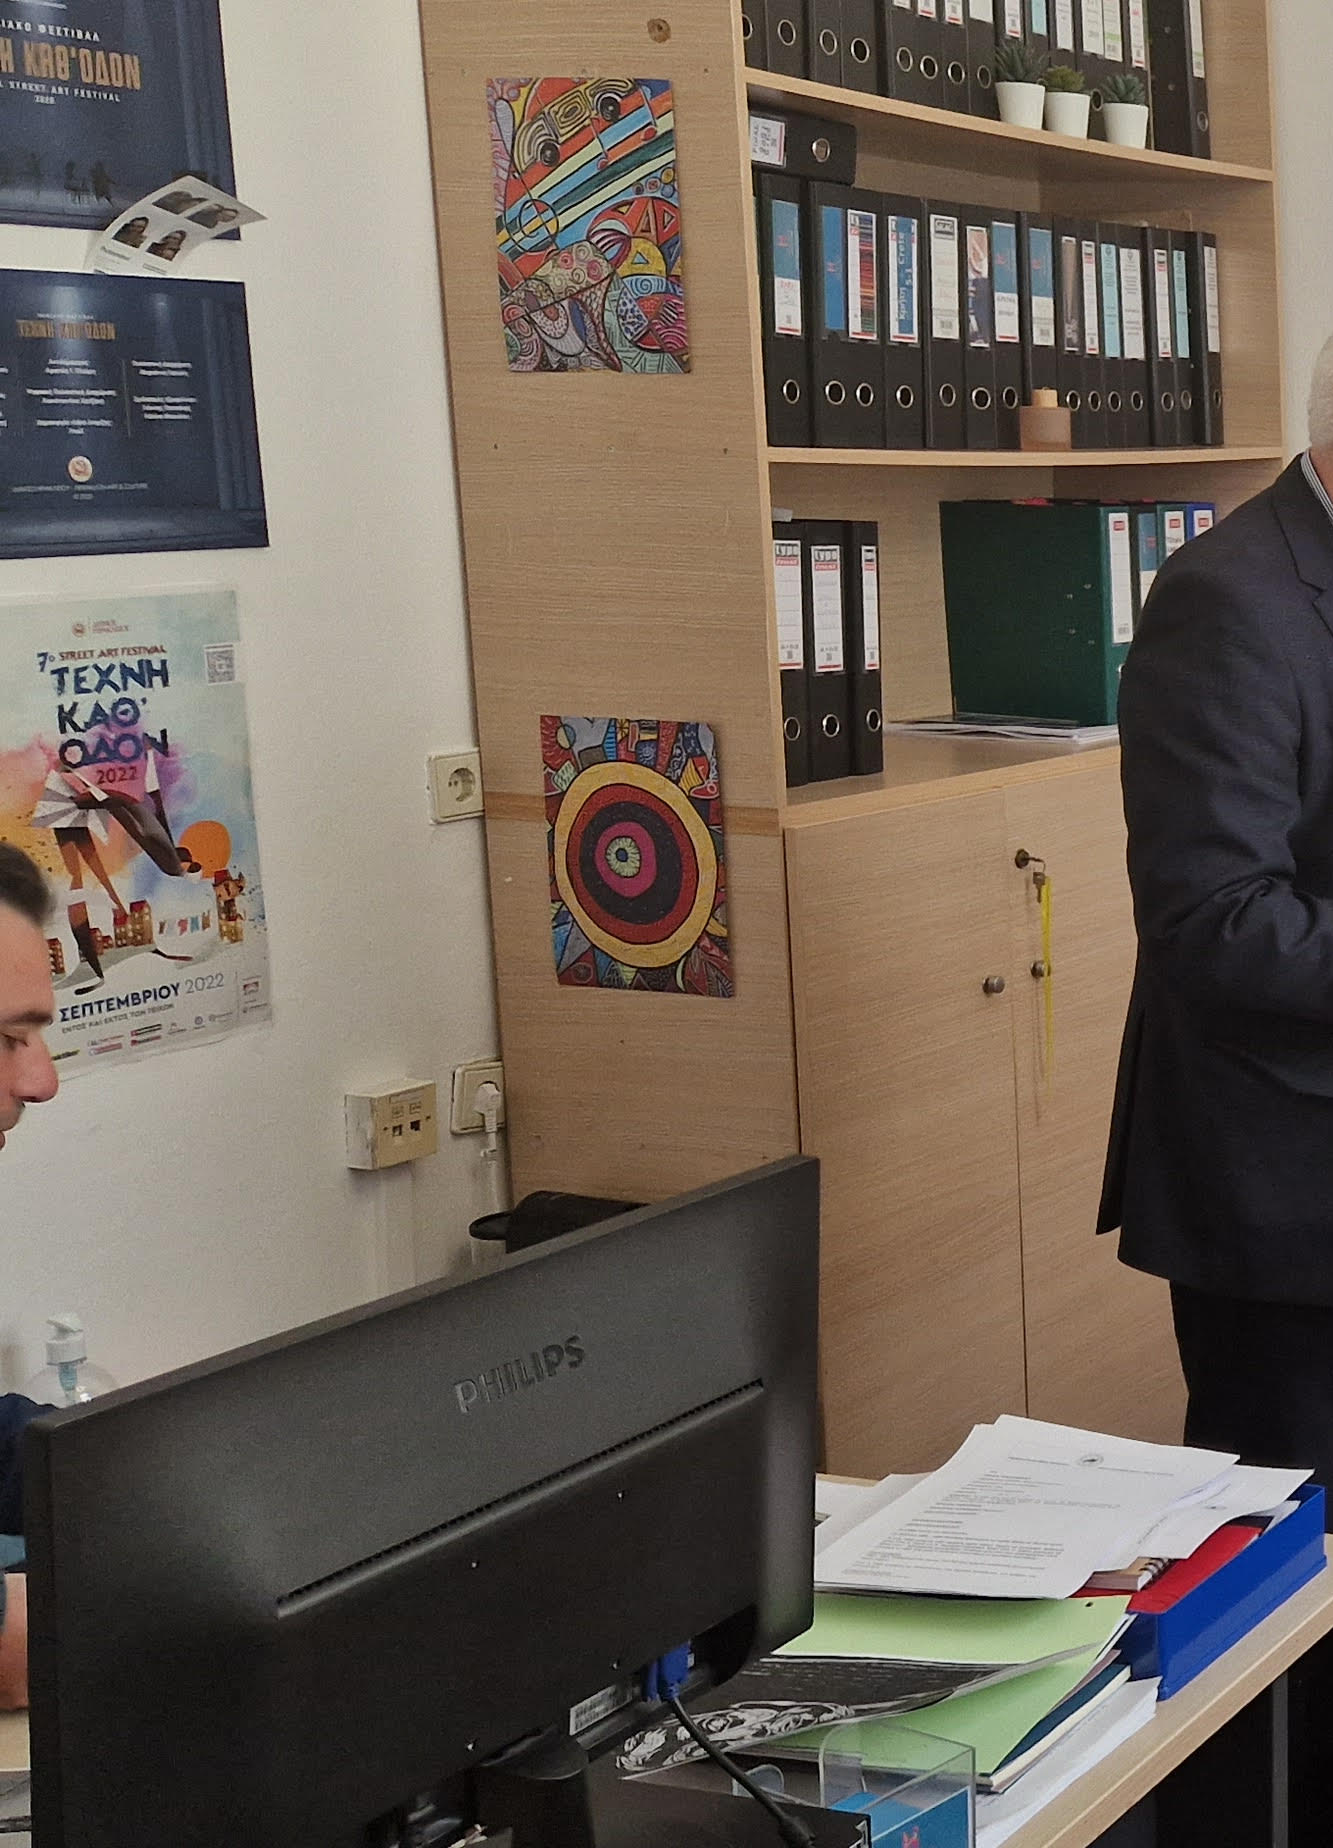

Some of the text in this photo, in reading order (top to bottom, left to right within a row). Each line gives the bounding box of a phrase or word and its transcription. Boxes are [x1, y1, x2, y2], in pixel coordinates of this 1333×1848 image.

[0, 19, 31, 32] ΙΑΚΟ
[51, 86, 69, 96] ART
[74, 88, 121, 103] FESTIVAL
[59, 645, 167, 661] STREET ART FESTIVAL
[50, 659, 170, 696] ΤΕΧΝΗ
[96, 766, 137, 784] 2022
[59, 972, 225, 1022] ΣΕΠΤΕΜΒΡΙΟΥ 2022
[454, 1334, 586, 1414] PHILIPS
